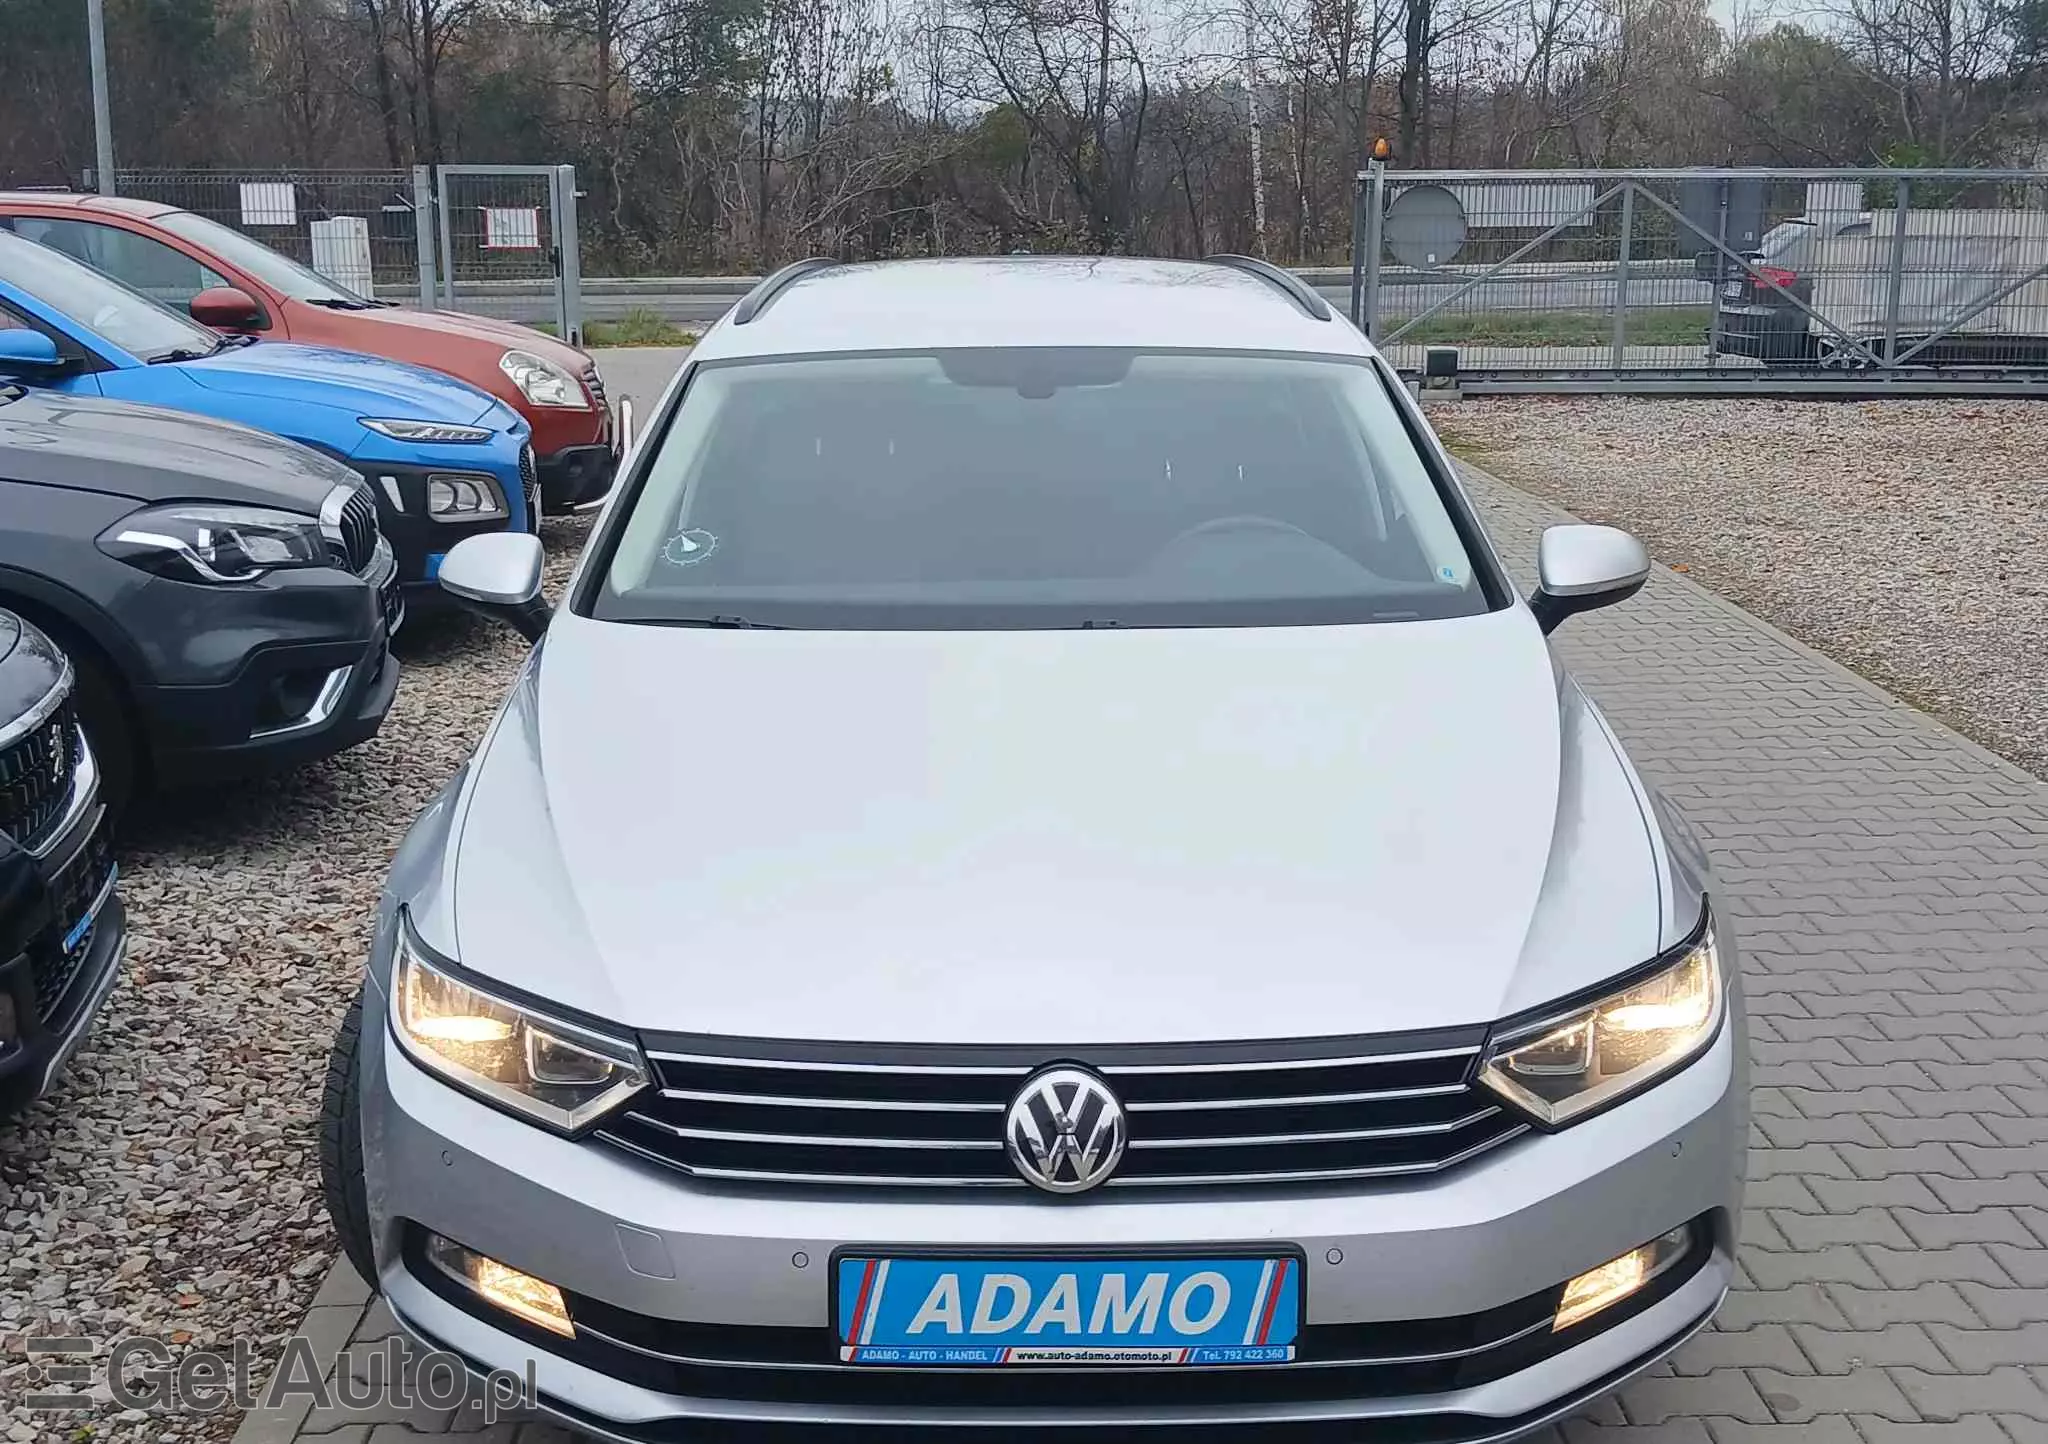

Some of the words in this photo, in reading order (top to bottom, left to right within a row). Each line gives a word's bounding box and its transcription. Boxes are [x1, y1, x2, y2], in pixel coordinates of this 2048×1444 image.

[905, 1271, 1231, 1335] ADAMO
[862, 1349, 899, 1360] ADAMO
[908, 1349, 937, 1361] AUTO
[946, 1349, 987, 1361] HANDEL
[1017, 1350, 1172, 1362] www.auto-adamo.otomoto.pl
[1223, 1350, 1242, 1360] 792
[1245, 1350, 1263, 1360] 422
[1265, 1349, 1284, 1360] 360
